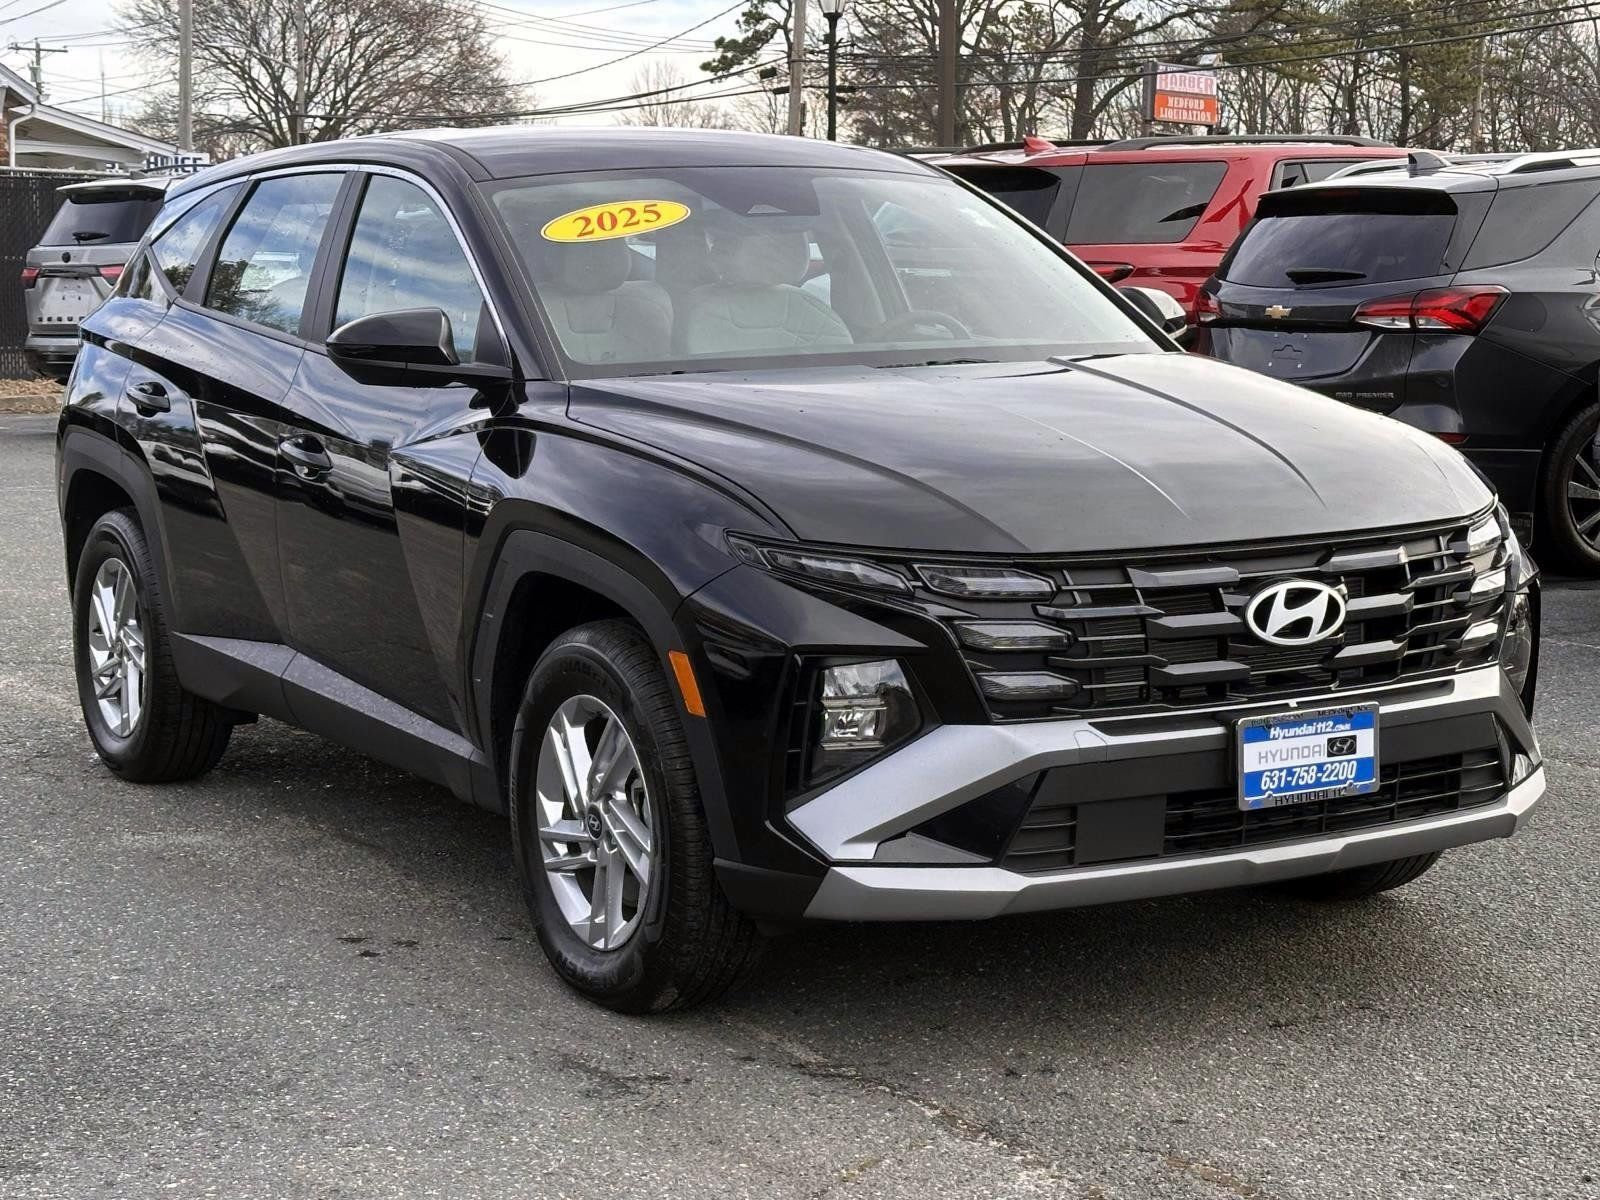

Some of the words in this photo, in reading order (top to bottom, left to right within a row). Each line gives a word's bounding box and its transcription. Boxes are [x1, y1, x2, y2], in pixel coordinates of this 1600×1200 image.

[1159, 107, 1212, 121] LIQUIDATION
[572, 203, 662, 238] 2025
[1258, 743, 1326, 765] HYUNDAI
[1260, 760, 1358, 790] 631-758-2200
[1274, 790, 1328, 806] HYUNDAI
